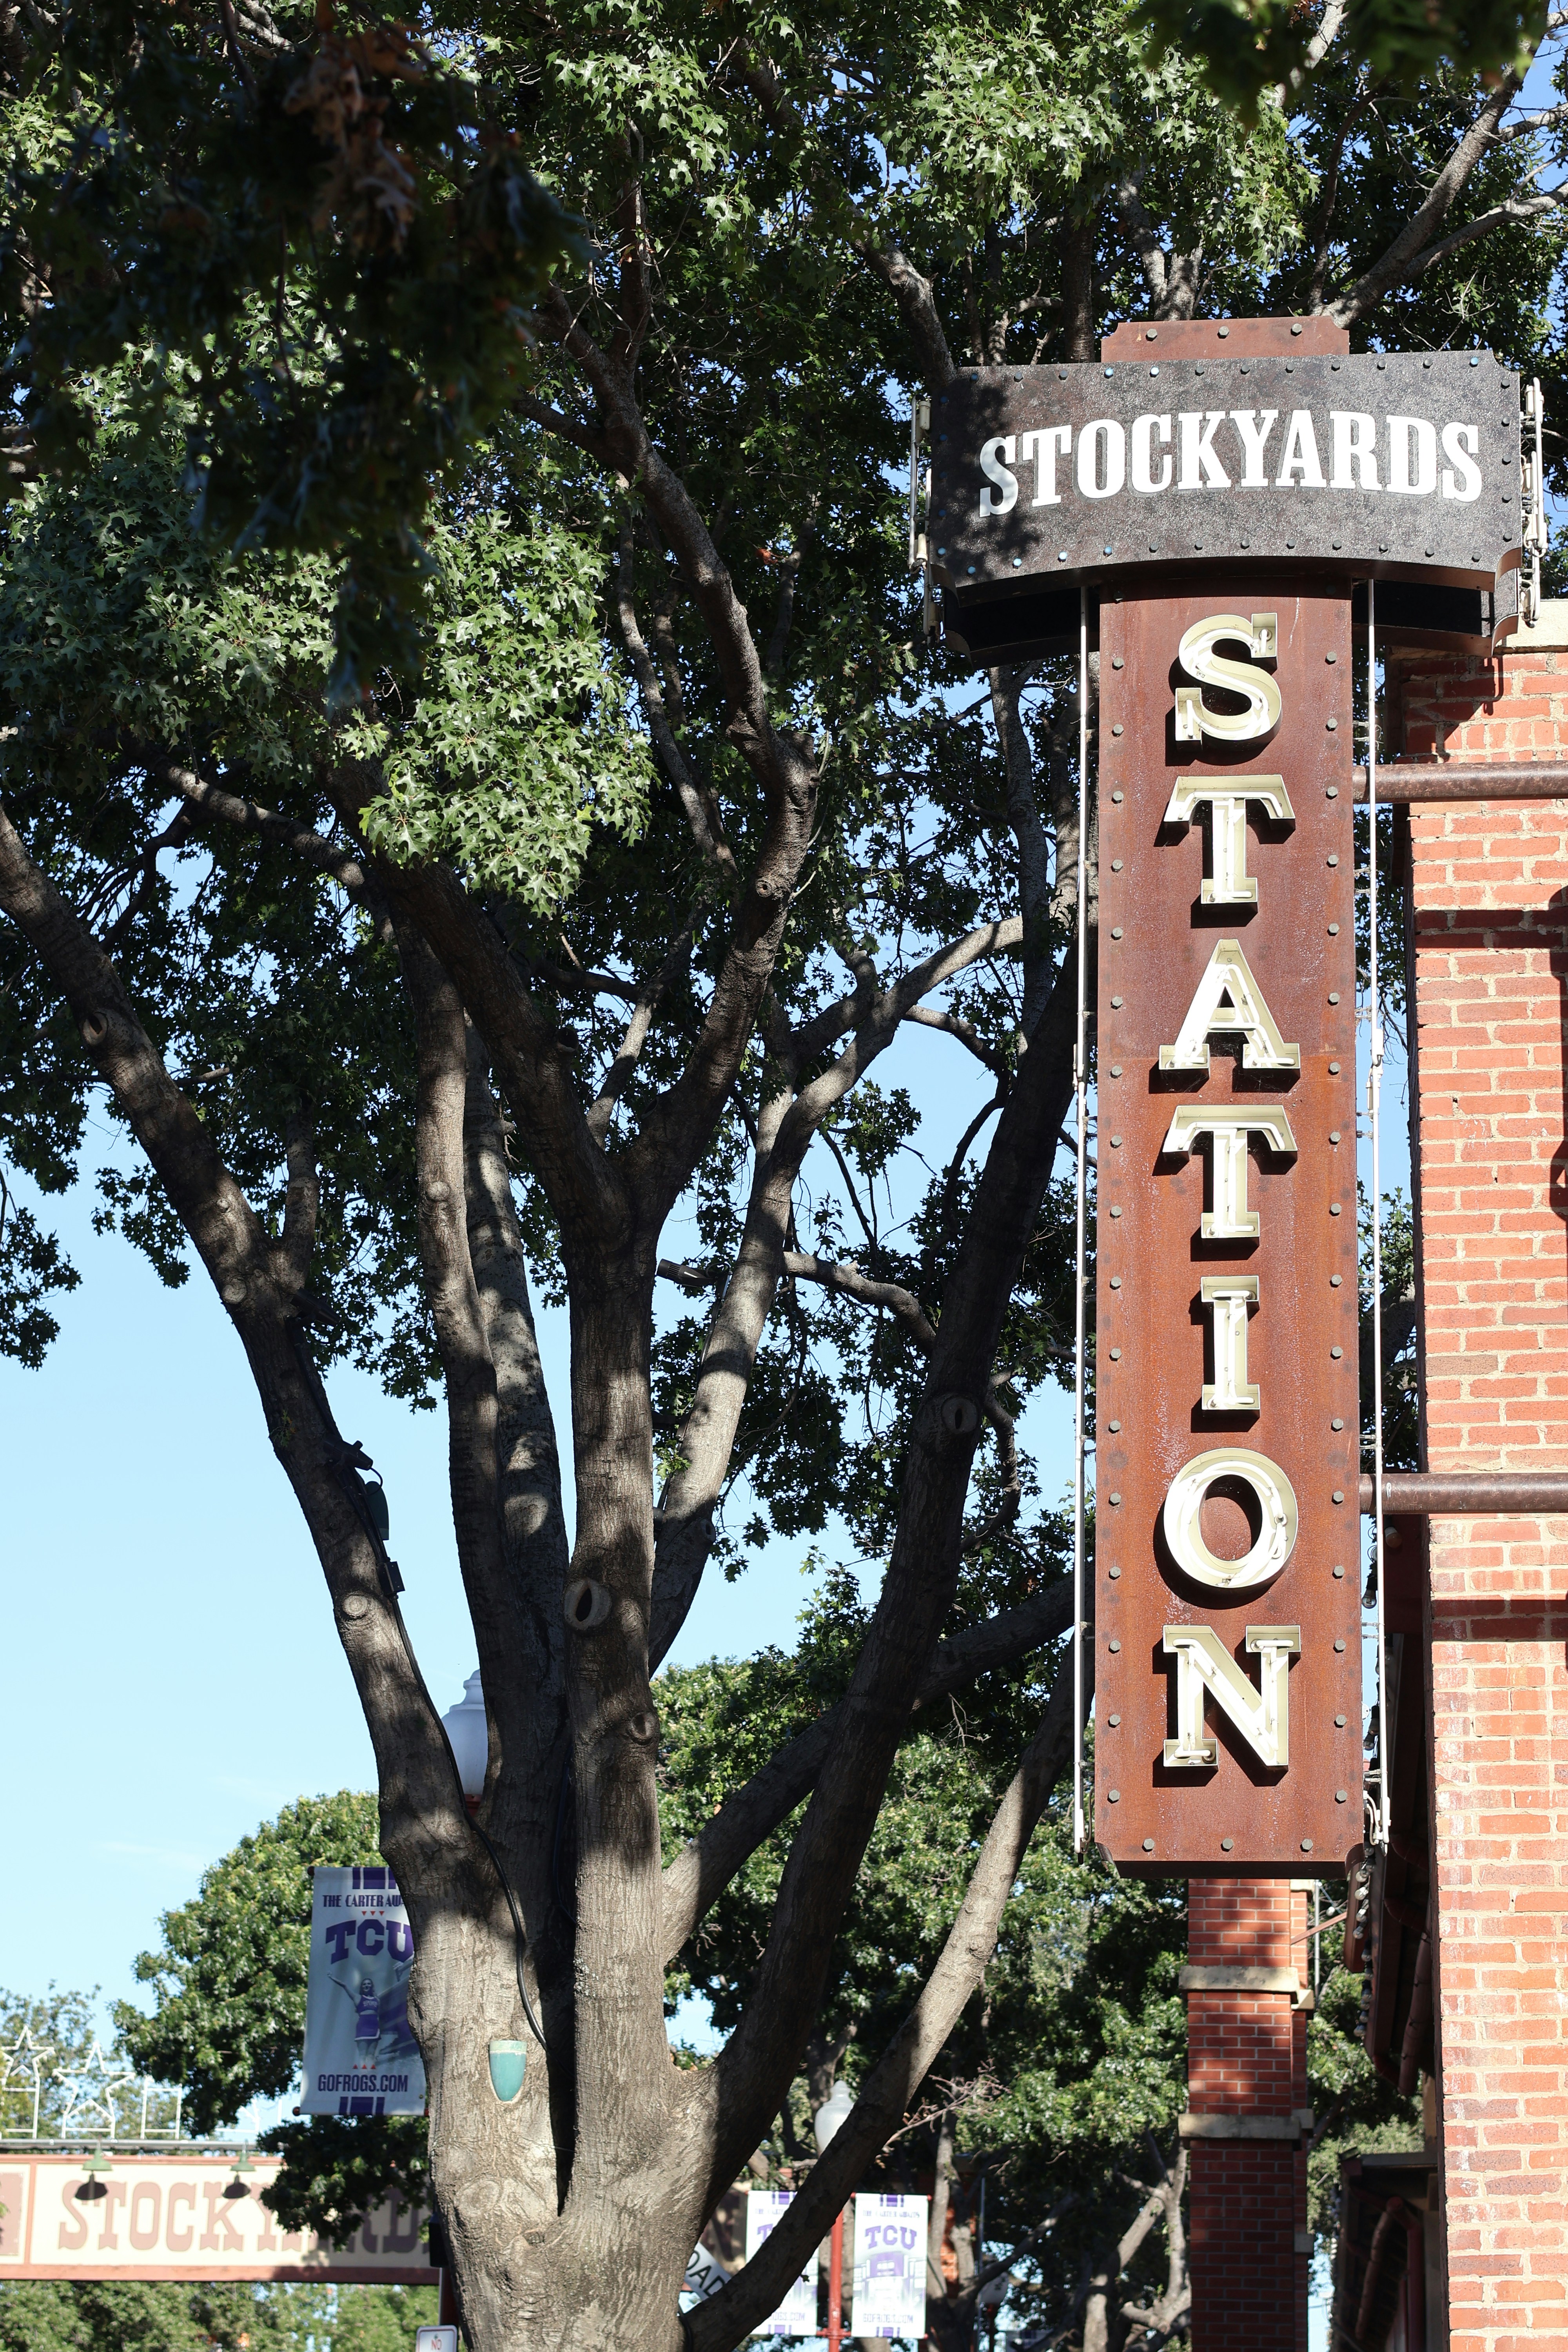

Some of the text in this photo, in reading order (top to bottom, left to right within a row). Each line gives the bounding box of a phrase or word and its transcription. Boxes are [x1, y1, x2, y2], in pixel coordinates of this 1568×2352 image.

[979, 409, 1483, 517] STOCKYARDS
[1158, 612, 1301, 1767] STATION
[322, 1895, 342, 1907] THE
[345, 1894, 384, 1907] CARTER
[325, 1919, 414, 1964] TCU
[318, 2074, 408, 2092] GOFROGS.COM
[865, 2225, 917, 2250] TCU
[432, 2339, 442, 2350] NO
